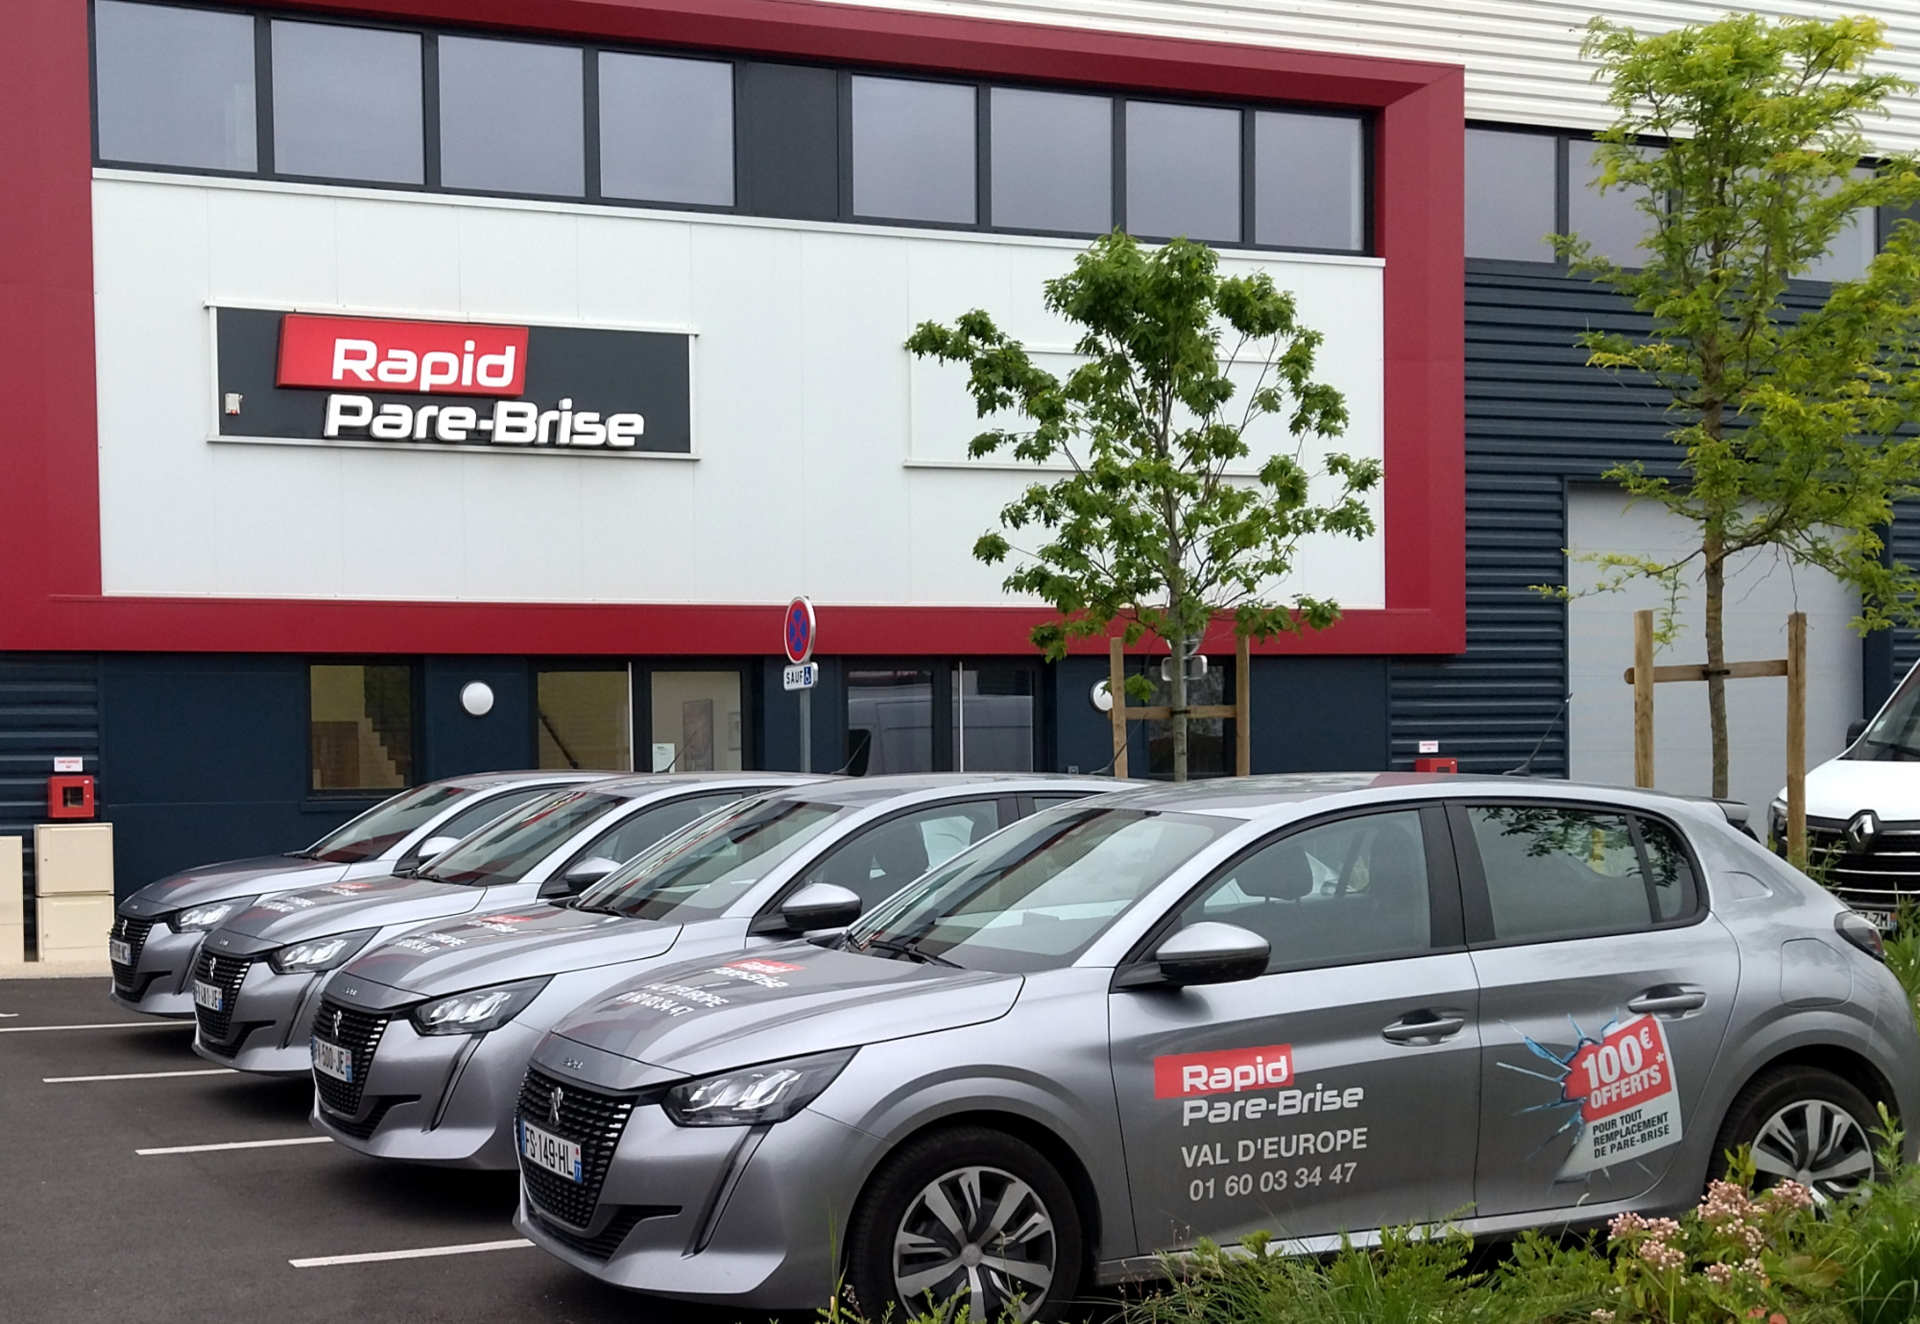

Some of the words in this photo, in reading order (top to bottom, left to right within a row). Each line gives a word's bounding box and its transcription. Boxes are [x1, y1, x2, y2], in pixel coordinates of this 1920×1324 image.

[331, 338, 516, 392] Rapid
[324, 394, 644, 446] Pare-Brise
[786, 670, 803, 684] SAUF
[1182, 1055, 1288, 1092] Rapid
[1182, 1082, 1364, 1126] Pare-Brise
[1592, 1118, 1618, 1136] POUR
[1619, 1109, 1643, 1126] TOUT
[1181, 1142, 1230, 1168] VAL
[1237, 1127, 1368, 1162] D'EUROPE
[1593, 1111, 1669, 1147] REMPLACEMENT
[1594, 1146, 1607, 1159] DE
[1610, 1124, 1670, 1154] PARE-BRISE
[525, 1125, 574, 1176] FS-149-HL
[1189, 1178, 1215, 1201] 01
[1225, 1173, 1252, 1197] 60
[1260, 1170, 1287, 1193] 03
[1294, 1166, 1322, 1189] 34
[1329, 1162, 1357, 1184] 47
